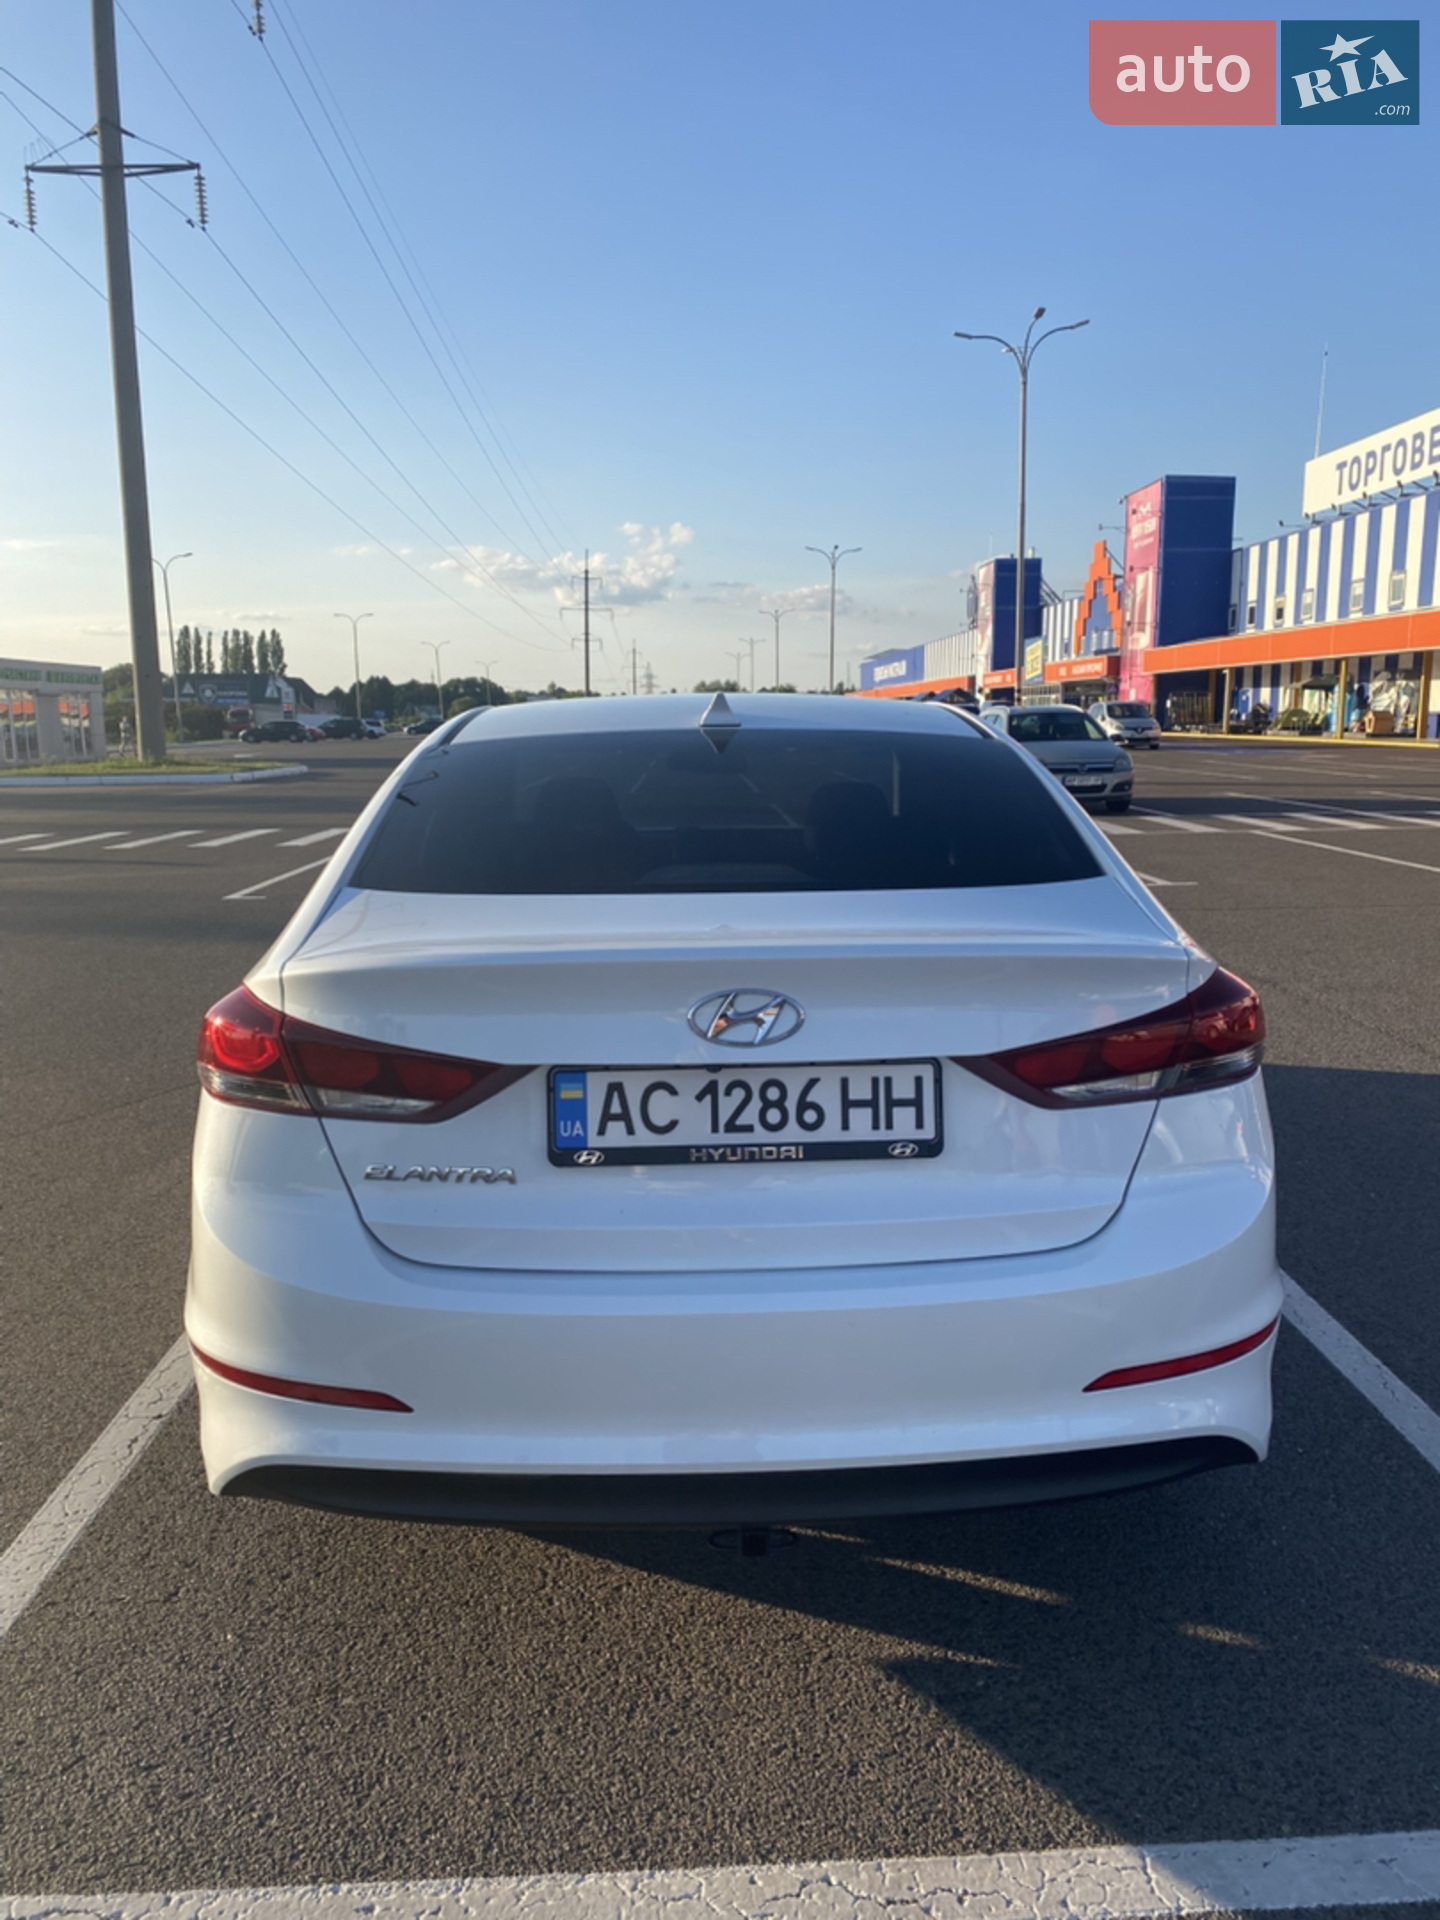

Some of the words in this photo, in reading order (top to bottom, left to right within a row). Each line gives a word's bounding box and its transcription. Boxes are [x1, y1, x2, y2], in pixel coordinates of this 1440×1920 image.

[596, 1081, 680, 1137] AC
[693, 1077, 826, 1134] 1286
[840, 1075, 925, 1132] HH
[559, 1119, 585, 1139] UA
[689, 1145, 804, 1162] HYUNDAI
[363, 1163, 517, 1185] ELANTRA
